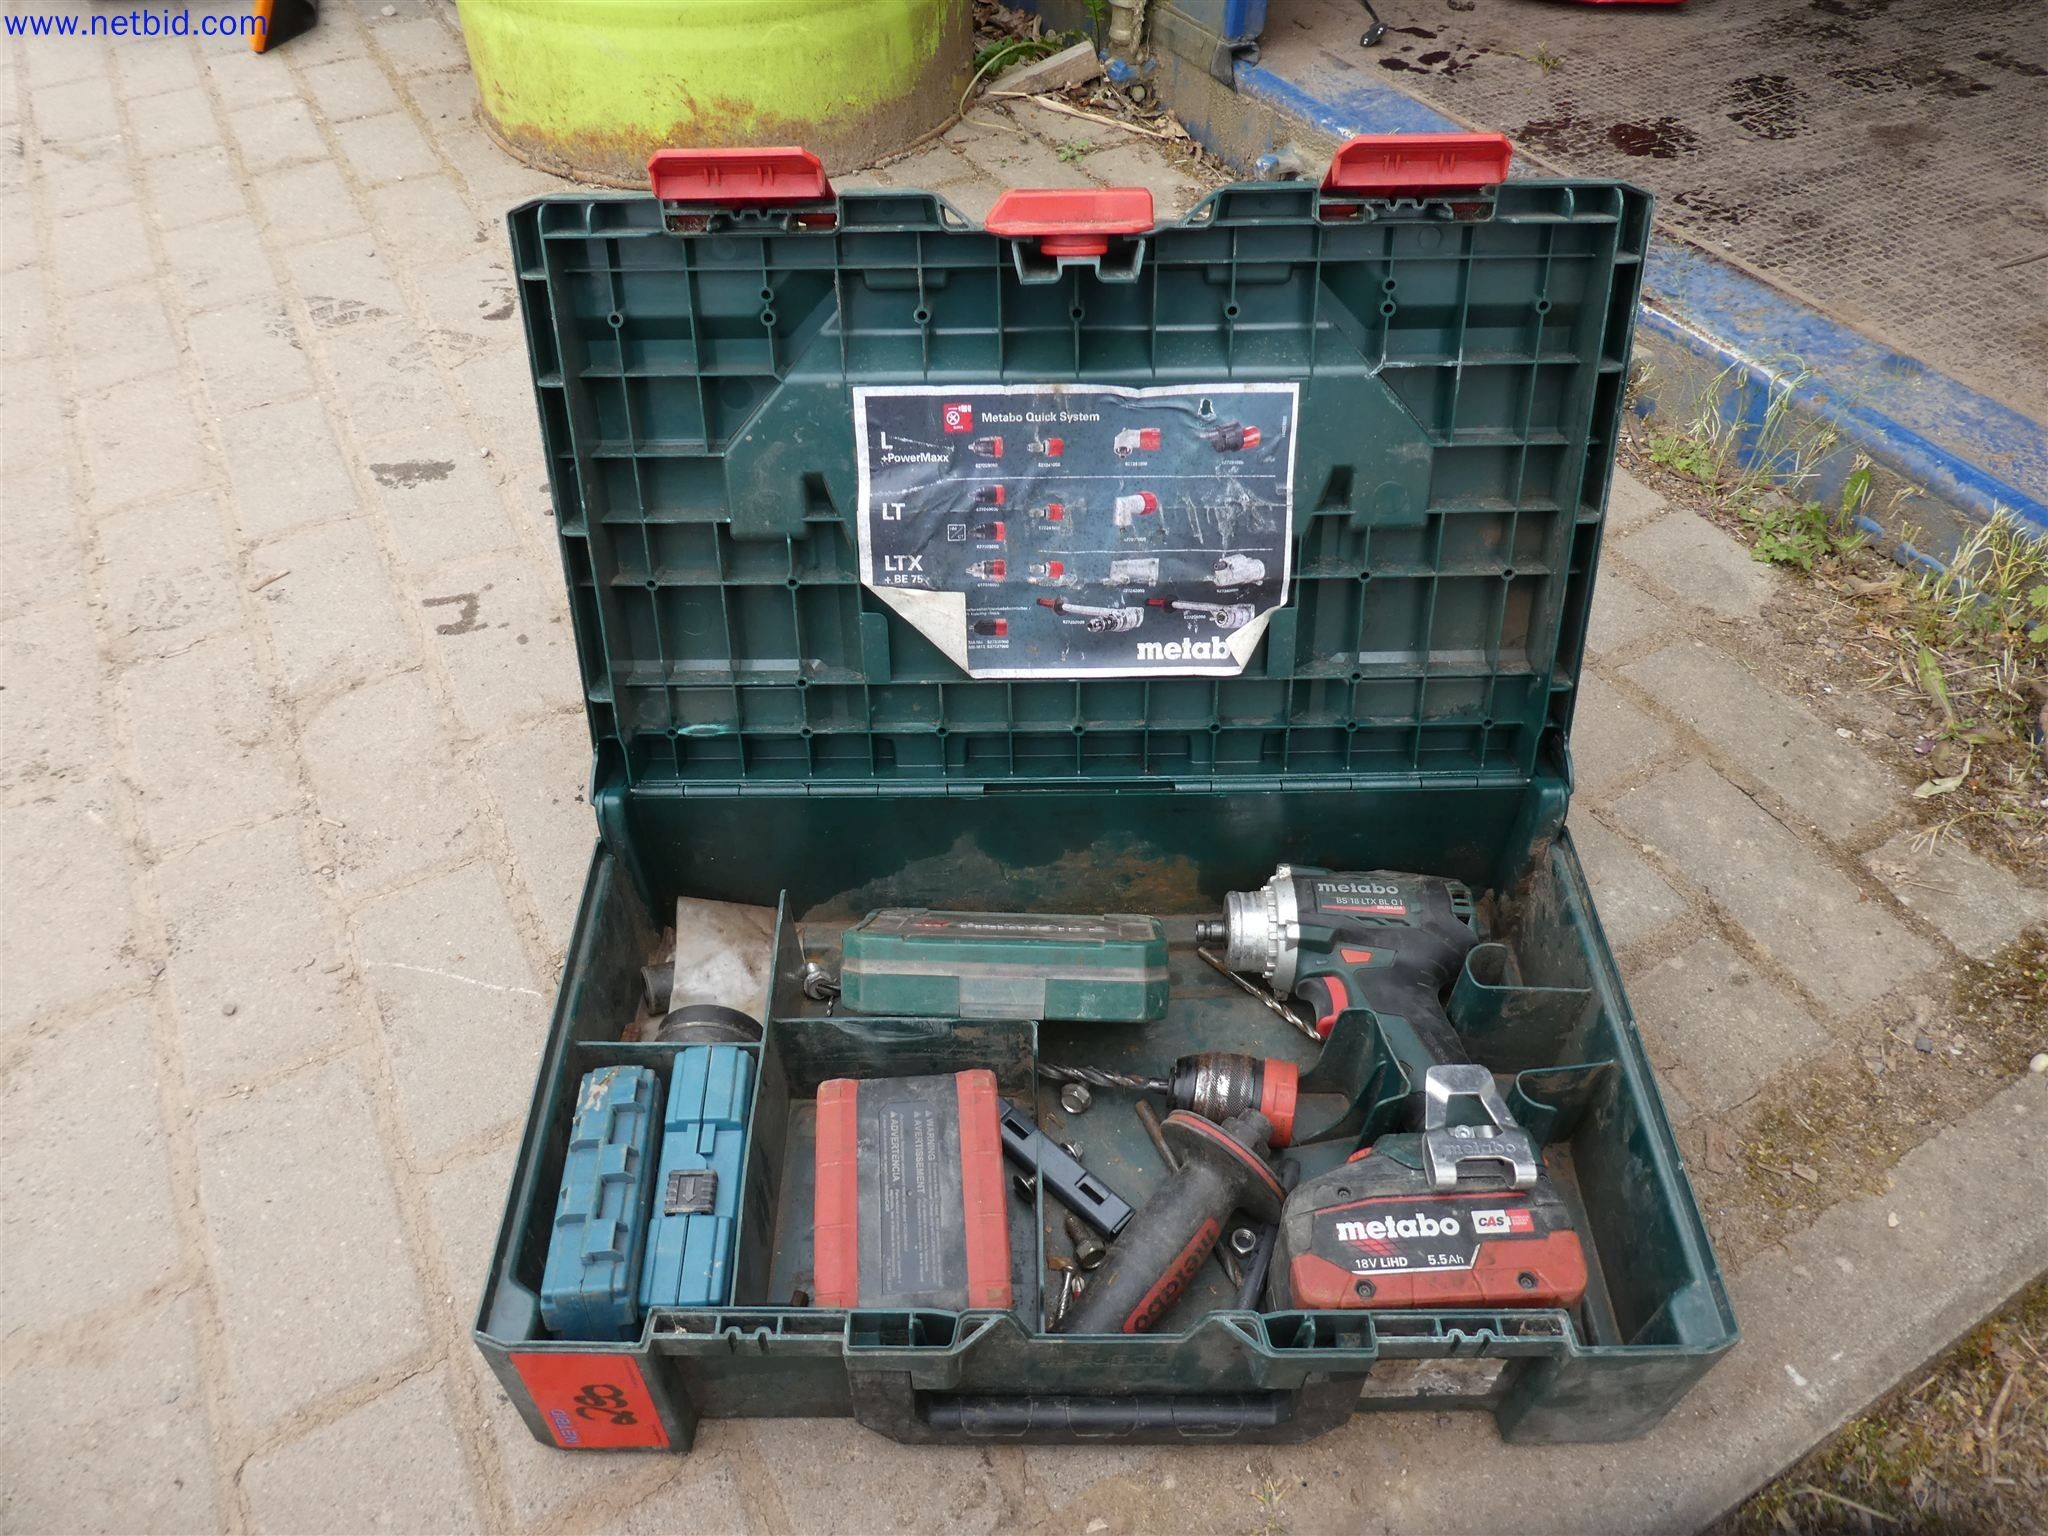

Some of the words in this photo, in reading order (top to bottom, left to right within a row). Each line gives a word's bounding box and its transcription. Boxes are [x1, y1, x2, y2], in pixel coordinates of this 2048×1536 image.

[982, 412, 1023, 423] Metabo
[1025, 412, 1057, 423] Quick
[1060, 412, 1100, 424] System
[881, 431, 894, 450] L
[882, 503, 906, 520] LT
[884, 555, 923, 571] LTX
[894, 575, 909, 584] BE
[911, 575, 923, 583] 75
[1137, 636, 1232, 660] metab
[1317, 881, 1399, 895] metabo
[926, 1118, 935, 1161] WARNING
[890, 1119, 901, 1183] ADVERTENCIA
[913, 1119, 925, 1194] AVERTISSEMENT
[1336, 1212, 1460, 1241] metabo
[1479, 1216, 1504, 1227] CAS
[1356, 1258, 1377, 1269] 18V
[1380, 1256, 1408, 1268] LiHD
